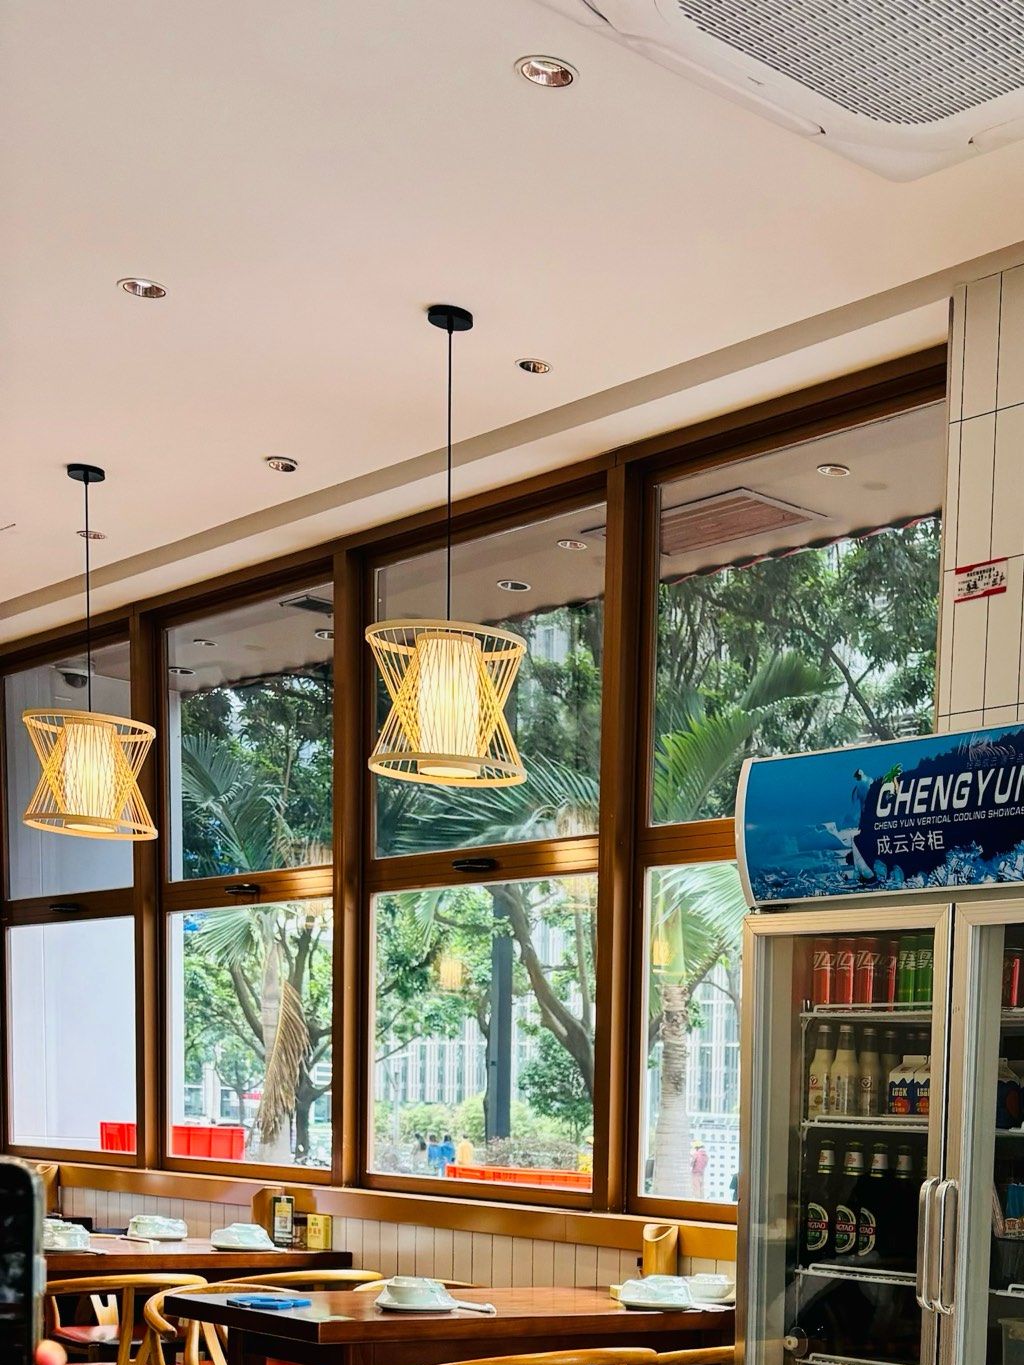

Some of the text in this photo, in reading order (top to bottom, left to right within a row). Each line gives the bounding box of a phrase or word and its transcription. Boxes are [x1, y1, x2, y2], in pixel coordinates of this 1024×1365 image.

[874, 821, 898, 831] CHENG
[900, 819, 916, 828] YUN
[916, 814, 952, 827] VERTICAL
[953, 810, 987, 822] COOLING
[876, 830, 945, 856] 成云冷柜
